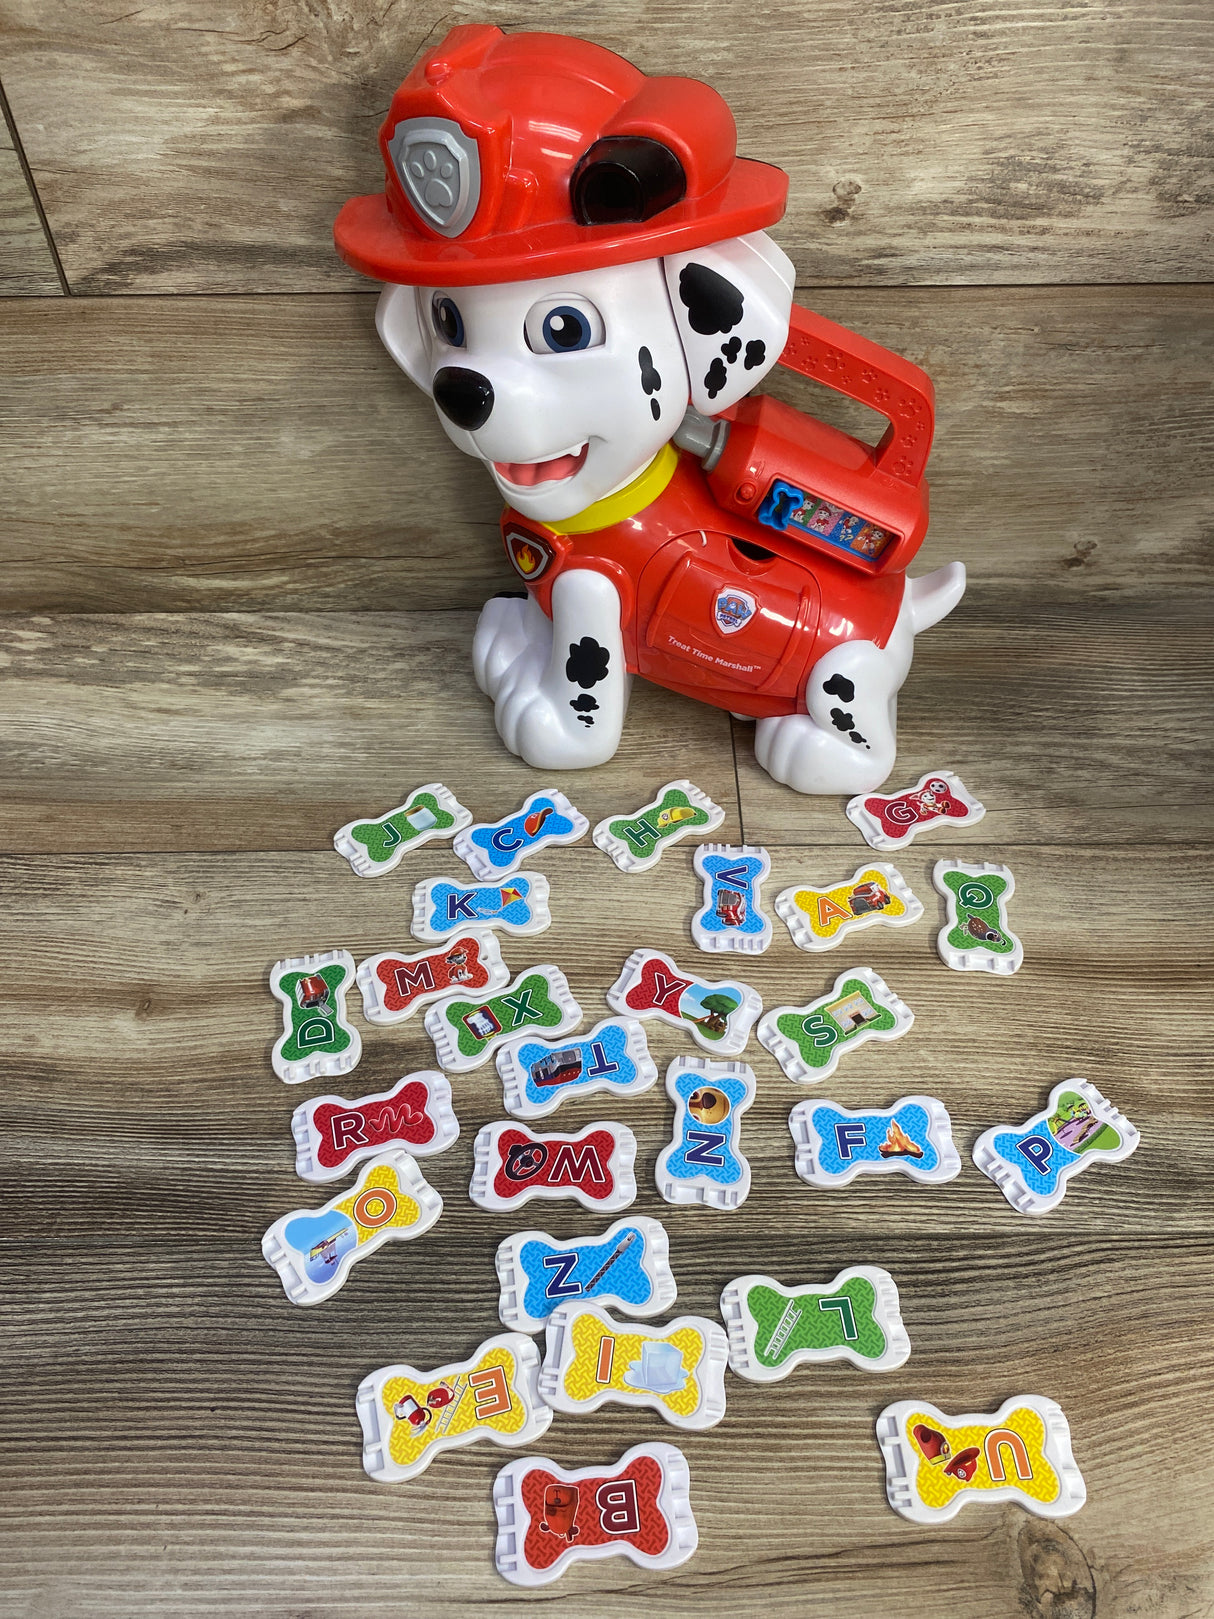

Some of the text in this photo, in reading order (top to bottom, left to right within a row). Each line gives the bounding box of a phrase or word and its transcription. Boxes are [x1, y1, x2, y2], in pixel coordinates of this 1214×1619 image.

[718, 598, 752, 620] PAW
[668, 635, 690, 653] Treat
[692, 648, 714, 662] Time
[884, 801, 919, 826] G
[381, 822, 401, 849] J
[491, 827, 524, 853] C
[623, 819, 661, 848] H
[715, 864, 748, 890] V
[446, 892, 478, 920] K
[818, 896, 852, 926] A
[957, 882, 994, 910] Q
[394, 961, 435, 997] M
[651, 972, 687, 1006] Y
[501, 989, 543, 1027] X
[297, 1016, 335, 1049] D
[802, 1014, 838, 1048] S
[587, 1041, 620, 1077] T
[329, 1110, 370, 1150] R
[833, 1122, 867, 1160] F
[685, 1130, 726, 1167] N
[1015, 1134, 1053, 1176] P
[353, 1187, 397, 1228] O
[542, 1252, 583, 1299] Z
[818, 1296, 860, 1341] L
[595, 1336, 615, 1384] I
[468, 1365, 512, 1420] E
[983, 1428, 1033, 1481] U
[595, 1479, 641, 1536] B
